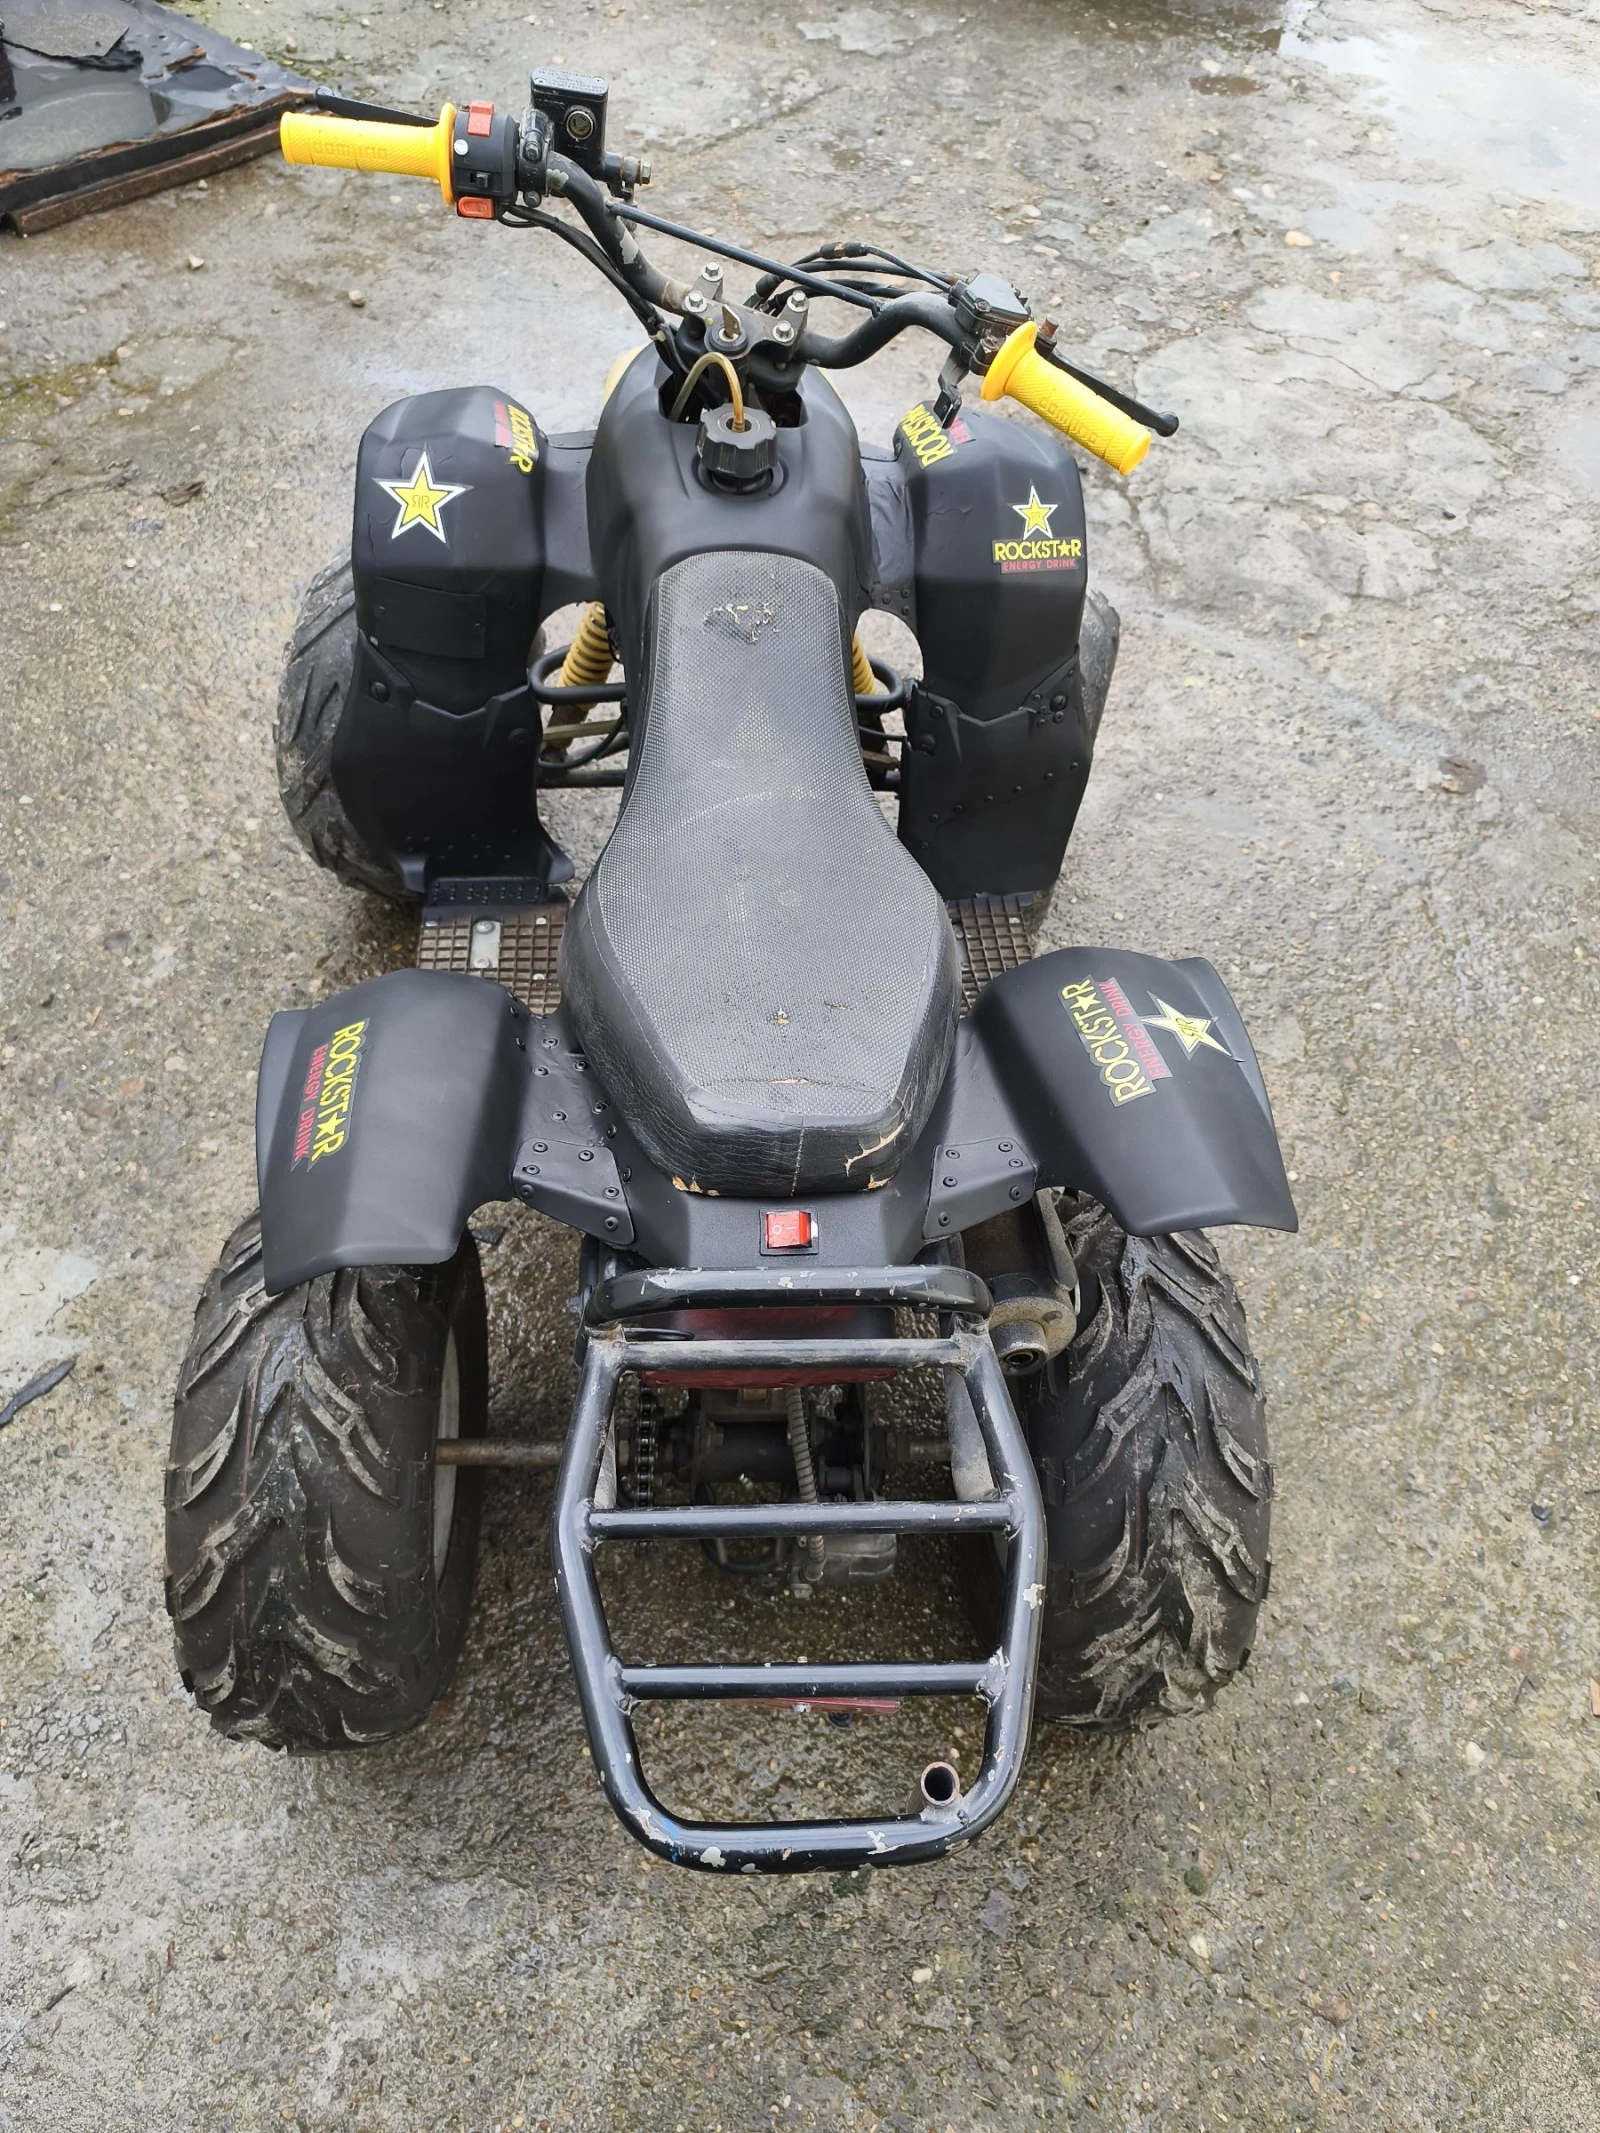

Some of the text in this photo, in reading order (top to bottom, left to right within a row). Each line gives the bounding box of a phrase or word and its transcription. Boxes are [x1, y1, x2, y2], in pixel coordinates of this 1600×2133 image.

[1003, 558, 1076, 571] ENERGY DRINK
[1099, 980, 1168, 1079] ENERGY DRINK
[294, 1043, 328, 1162] ENERGY DRINK
